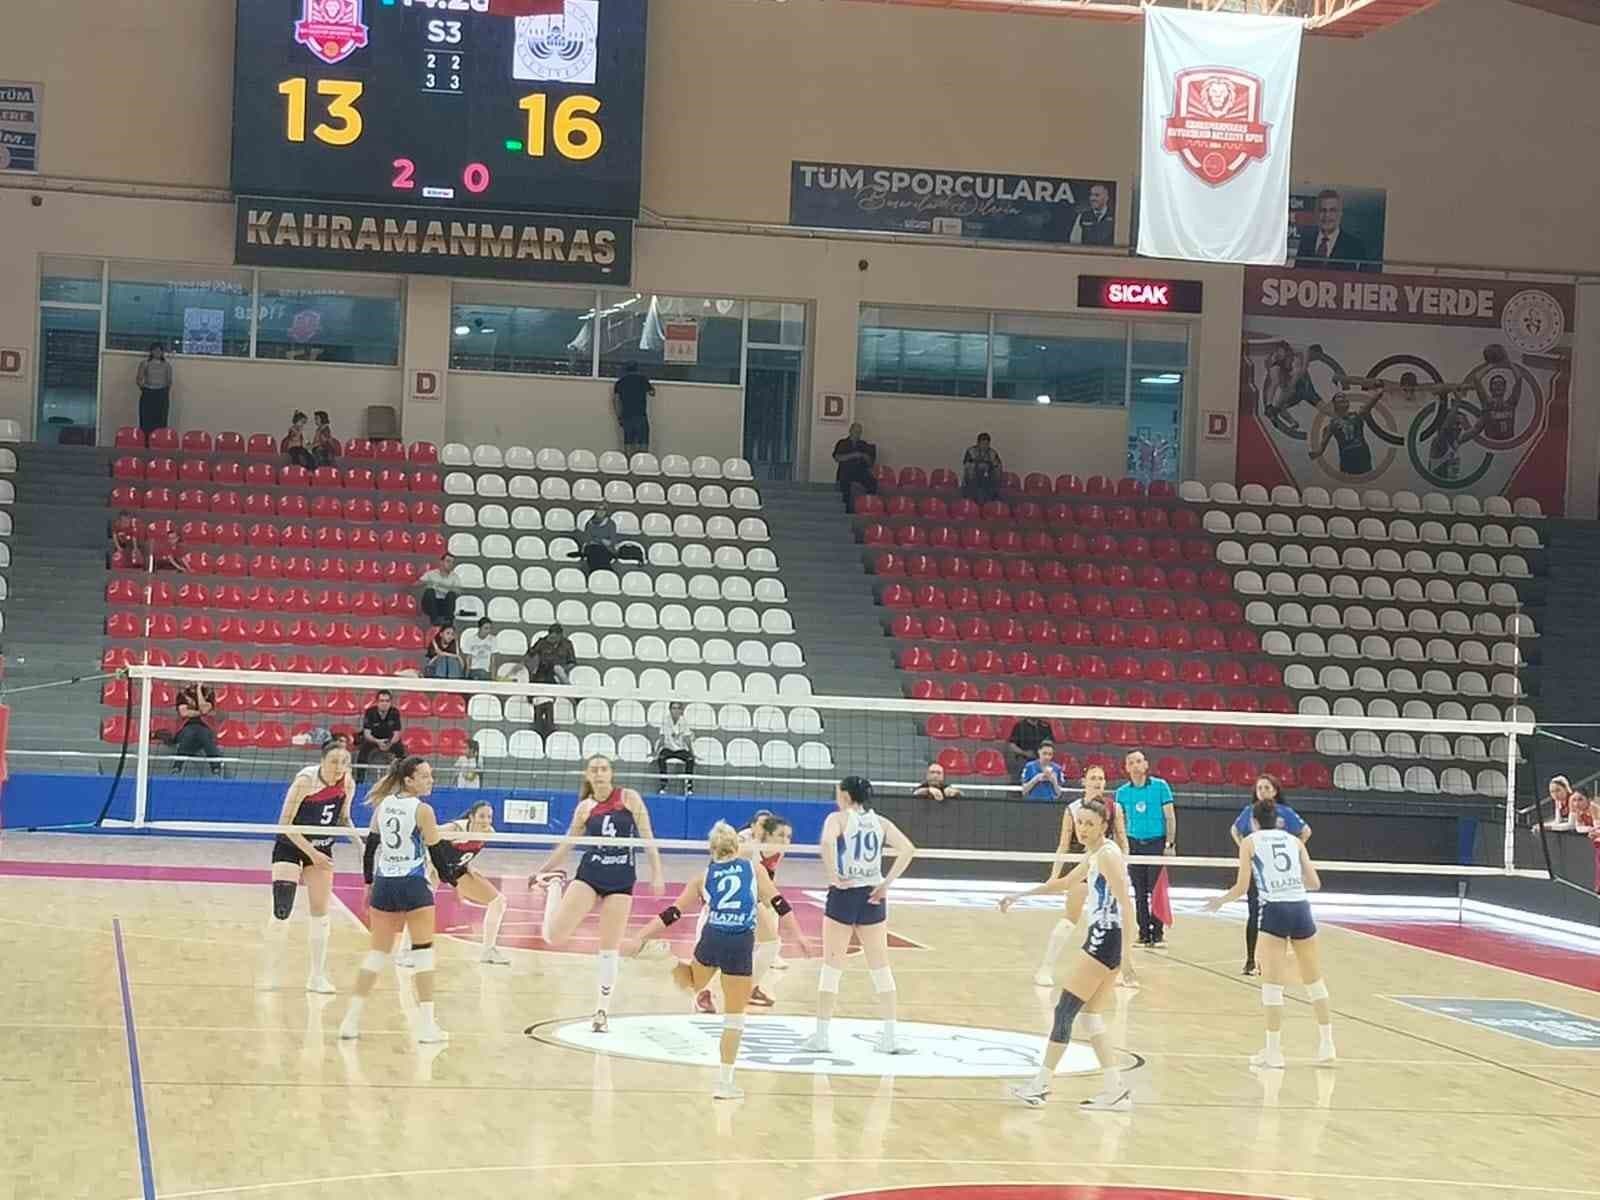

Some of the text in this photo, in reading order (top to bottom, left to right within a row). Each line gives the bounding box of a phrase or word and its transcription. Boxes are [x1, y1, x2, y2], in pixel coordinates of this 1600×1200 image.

[427, 19, 462, 43] S3
[426, 53, 461, 70] 2 2
[425, 74, 460, 89] 3 3
[278, 77, 363, 145] 13
[518, 92, 602, 160] 16
[392, 158, 415, 189] 2
[463, 162, 490, 193] 0
[800, 166, 1075, 204] TÜM SPORCULARA
[246, 209, 616, 273] KAHRAMANMARAŞ
[1108, 284, 1168, 305] SICAK
[1261, 278, 1494, 317] SPOR HER YERDE
[1, 351, 21, 372] D
[416, 372, 436, 394] D
[824, 395, 843, 417] D
[1208, 414, 1227, 435] D
[320, 804, 336, 825] 5
[385, 816, 403, 850] 3
[850, 829, 879, 863] 19
[1271, 843, 1292, 873] 5
[716, 874, 743, 910] 2
